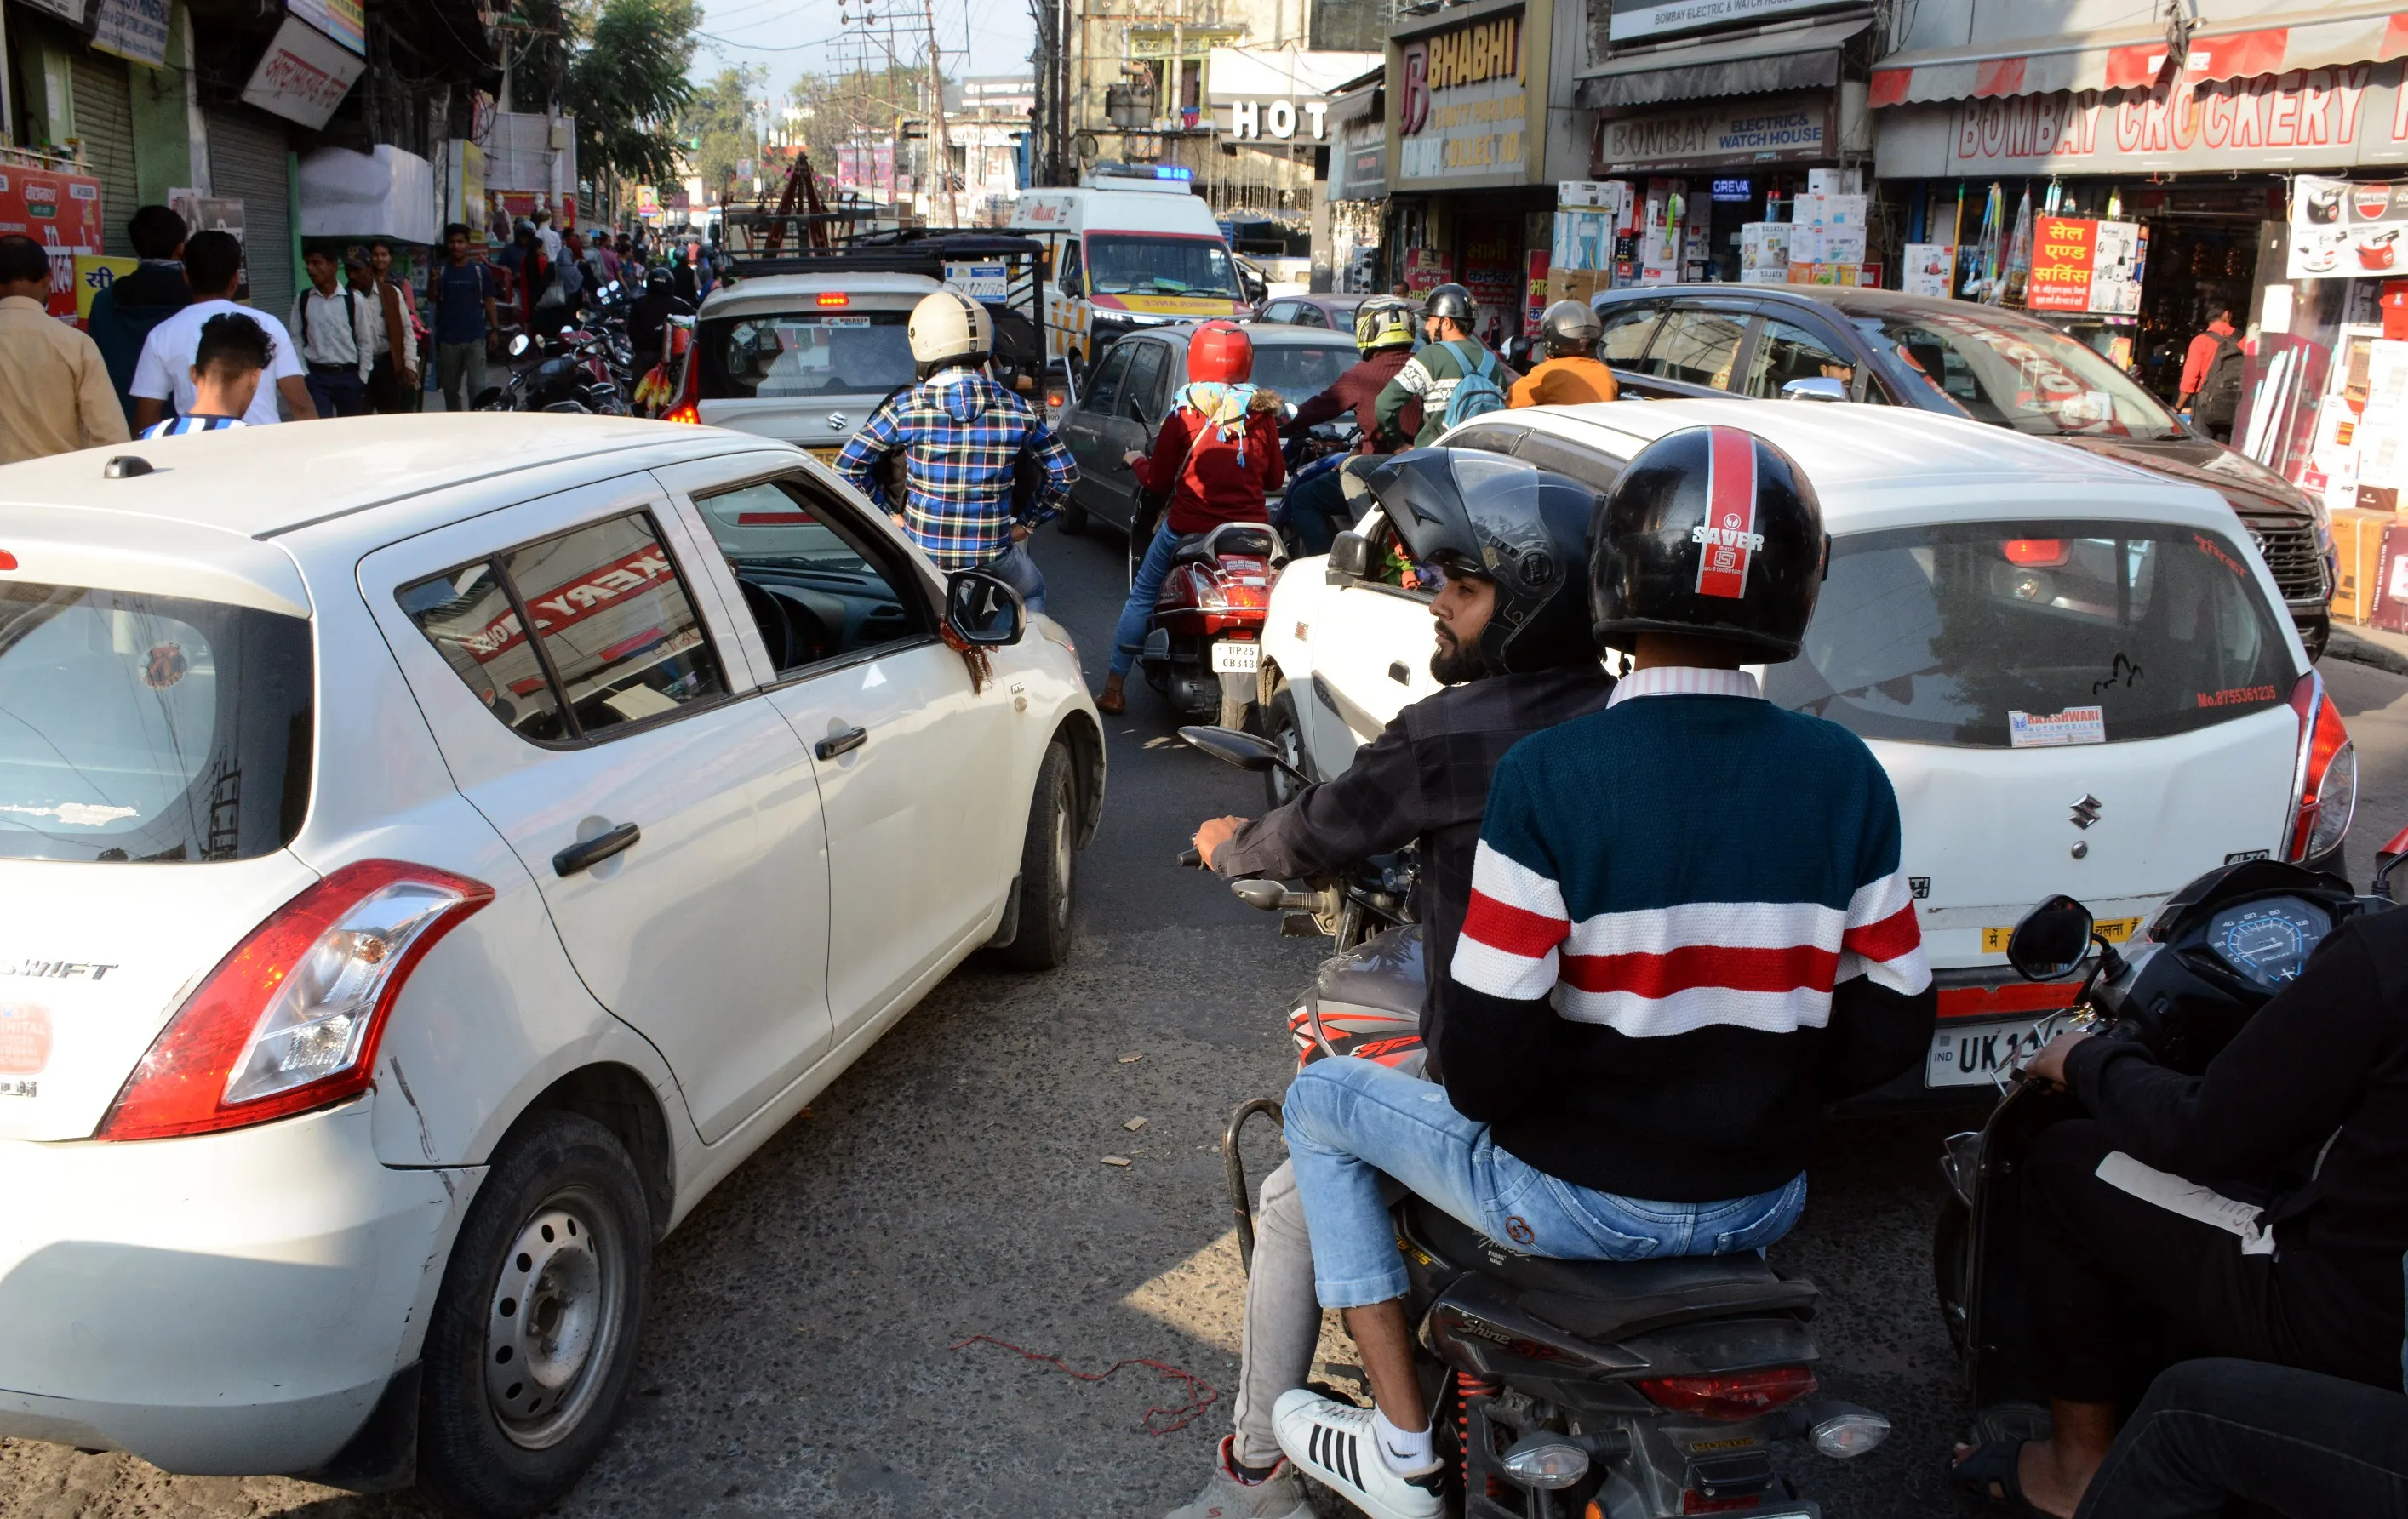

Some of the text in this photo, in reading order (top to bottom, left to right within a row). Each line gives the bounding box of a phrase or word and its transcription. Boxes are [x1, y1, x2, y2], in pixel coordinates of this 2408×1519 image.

[1655, 9, 1685, 25] BOMBAY
[1687, 4, 1724, 20] ELECTRIC
[1727, 3, 1732, 12] &
[1427, 17, 1519, 91] BHABHI
[1232, 99, 1328, 140] HOT
[1429, 101, 1471, 131] BEAUTY
[1958, 91, 2106, 159] BOMBAY
[2116, 65, 2371, 153] CROCKERY
[1611, 113, 1715, 159] BOMBAY
[1719, 127, 1822, 150] WATCH HOUSE
[1713, 180, 1749, 193] OREVA
[2049, 221, 2085, 241] सेल
[2045, 244, 2087, 261] एण्ड
[2034, 263, 2091, 283] सर्विस
[1691, 526, 1765, 551] SAVER
[1228, 646, 1255, 656] UP25
[2028, 722, 2101, 733] AUTOMOBILES
[2228, 850, 2269, 865] ALTO
[1934, 1052, 1953, 1063] IND
[1489, 1256, 1503, 1266] KING
[1460, 1318, 1512, 1345] Shine
